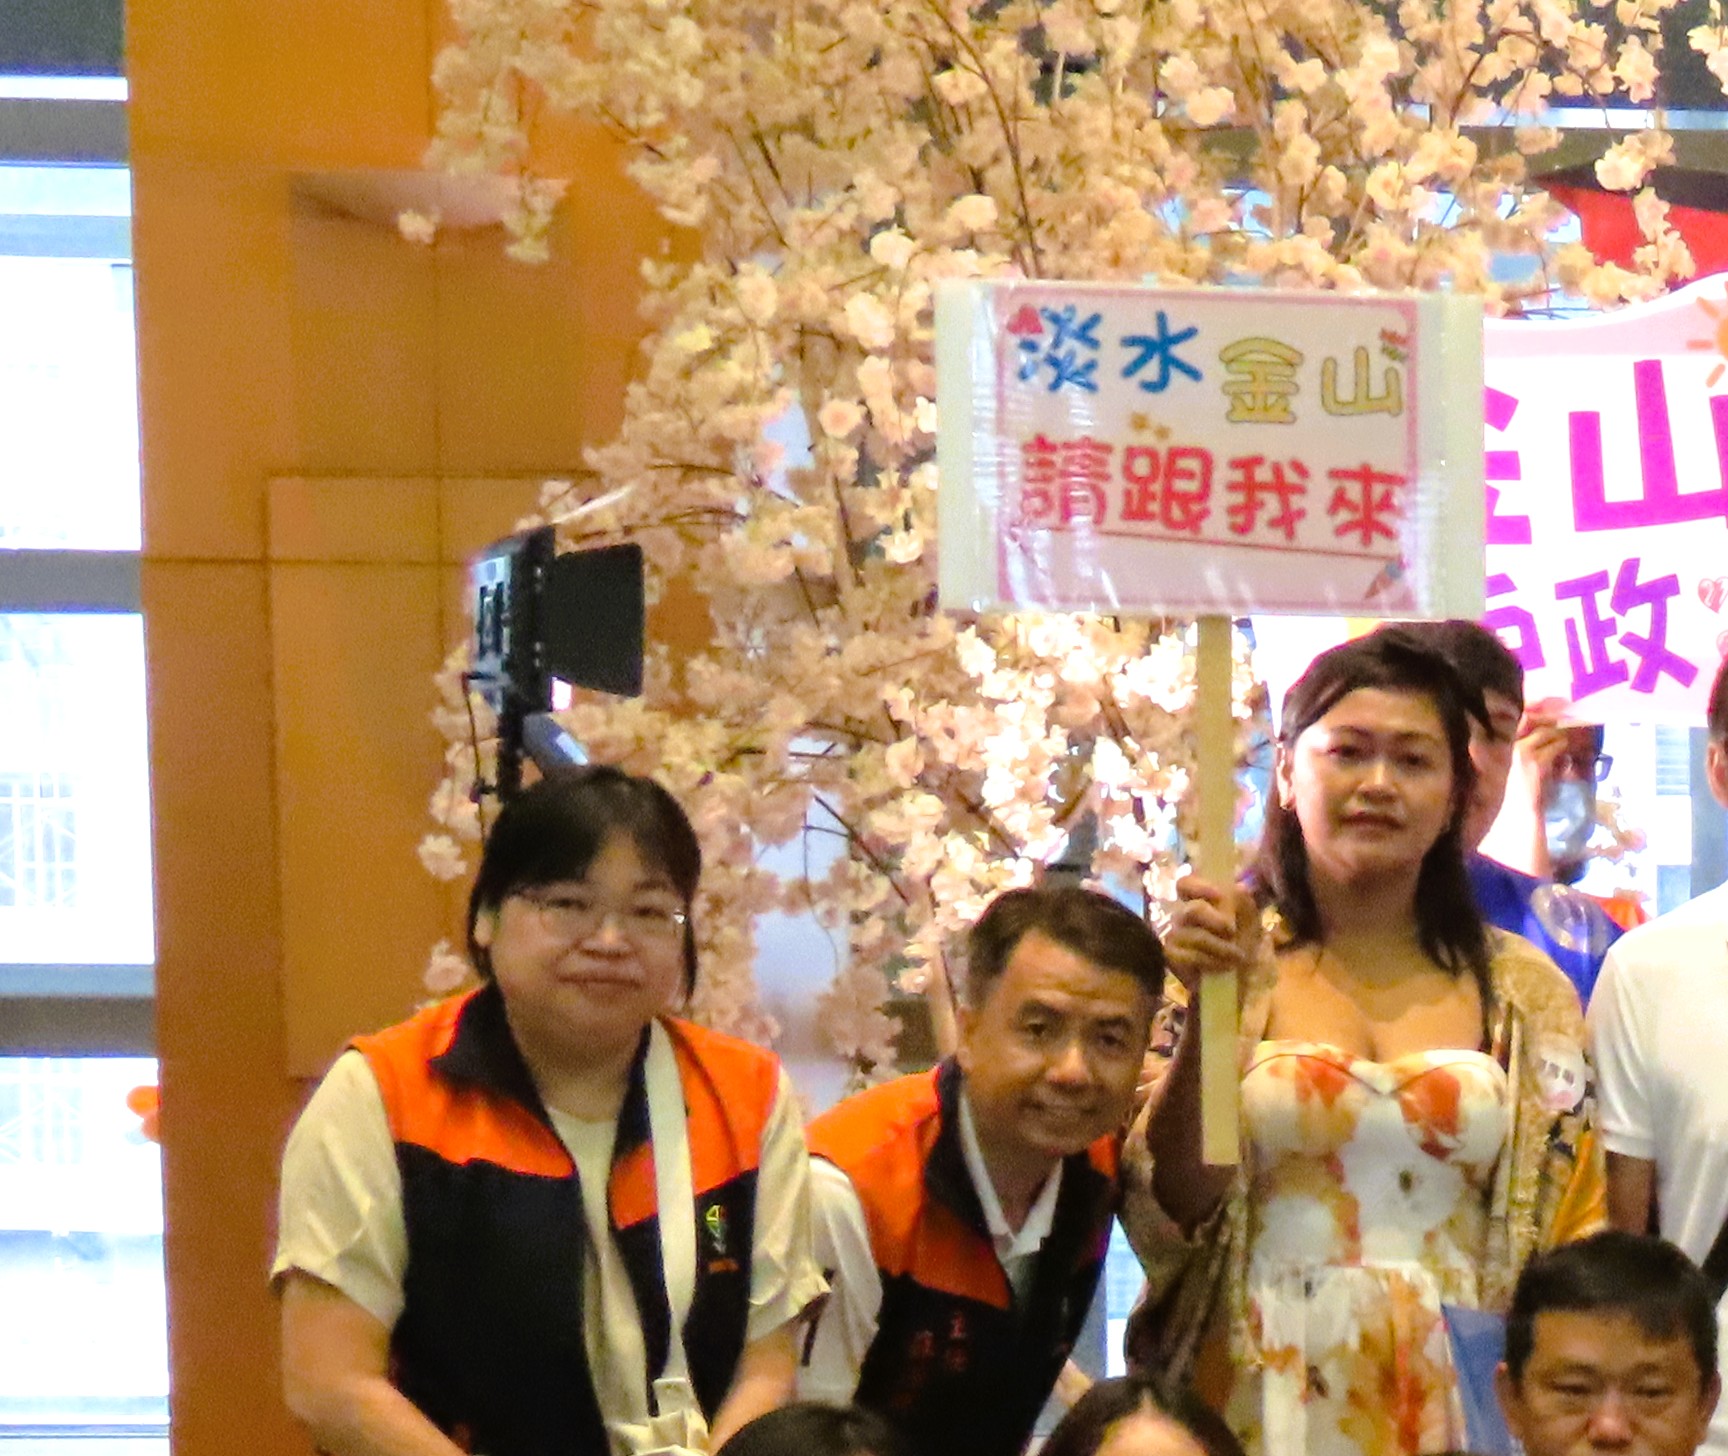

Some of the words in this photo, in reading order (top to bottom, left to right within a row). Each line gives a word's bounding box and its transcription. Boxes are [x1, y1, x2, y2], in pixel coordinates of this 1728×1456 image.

[1014, 303, 1402, 425] 淡水金山
[1020, 435, 1406, 547] 請跟我來
